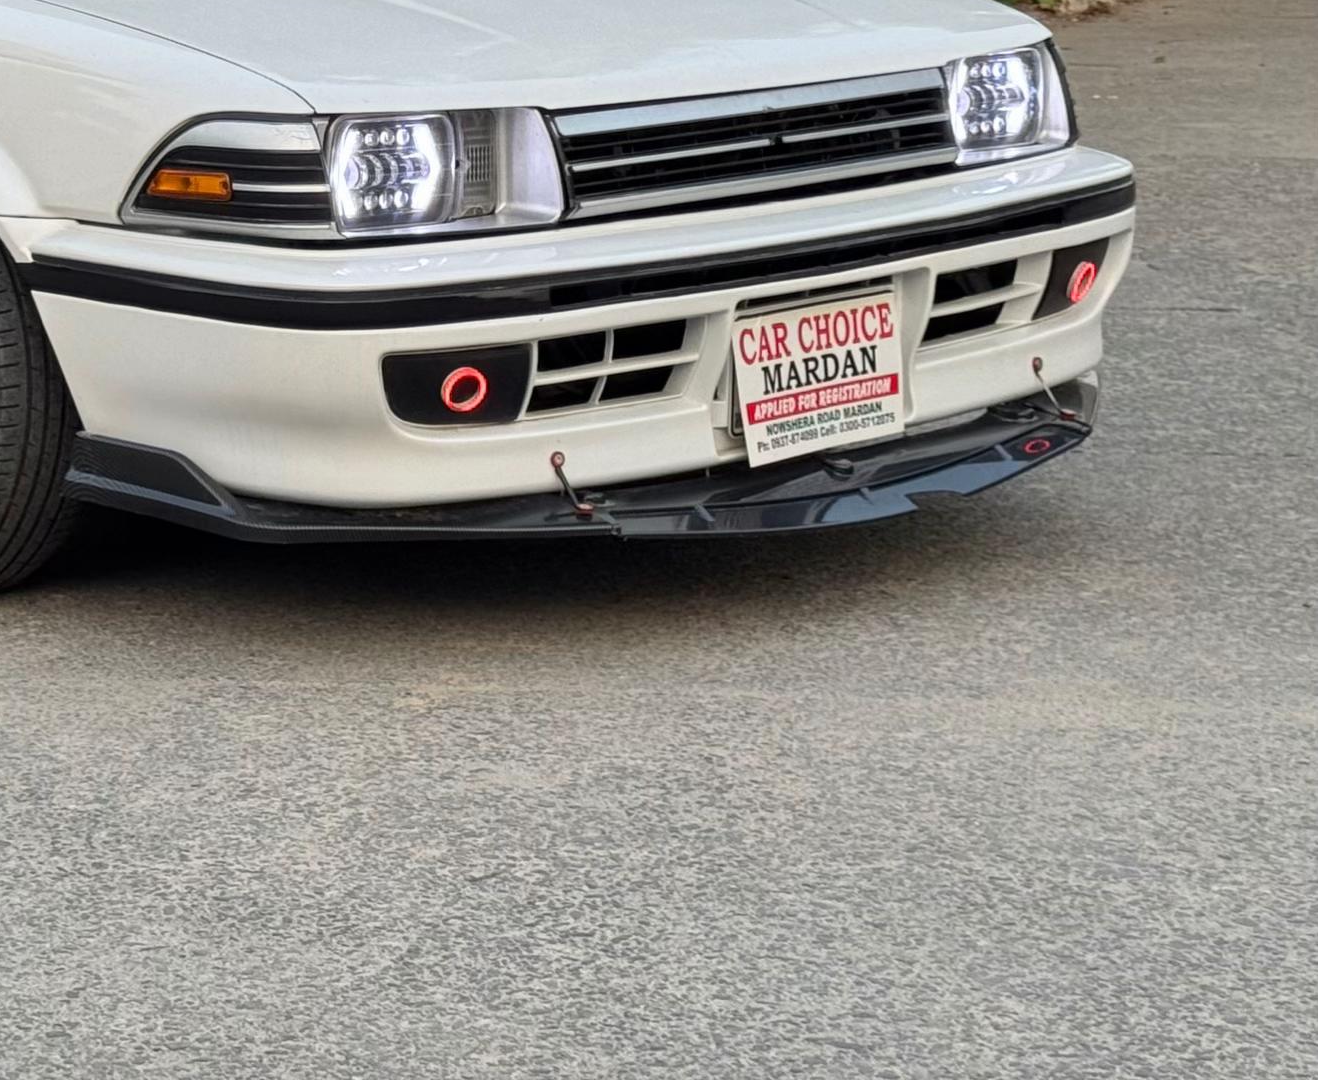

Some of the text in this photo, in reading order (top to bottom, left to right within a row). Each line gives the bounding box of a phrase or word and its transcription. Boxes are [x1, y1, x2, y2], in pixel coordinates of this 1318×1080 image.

[739, 302, 894, 365] CAR CHOICE
[762, 345, 878, 395] MARDAN
[754, 377, 892, 420] APPLIED FOR REGISTRATION
[766, 401, 883, 436] NOWSHERA ROAD MARDAN
[821, 425, 837, 437] Cell:
